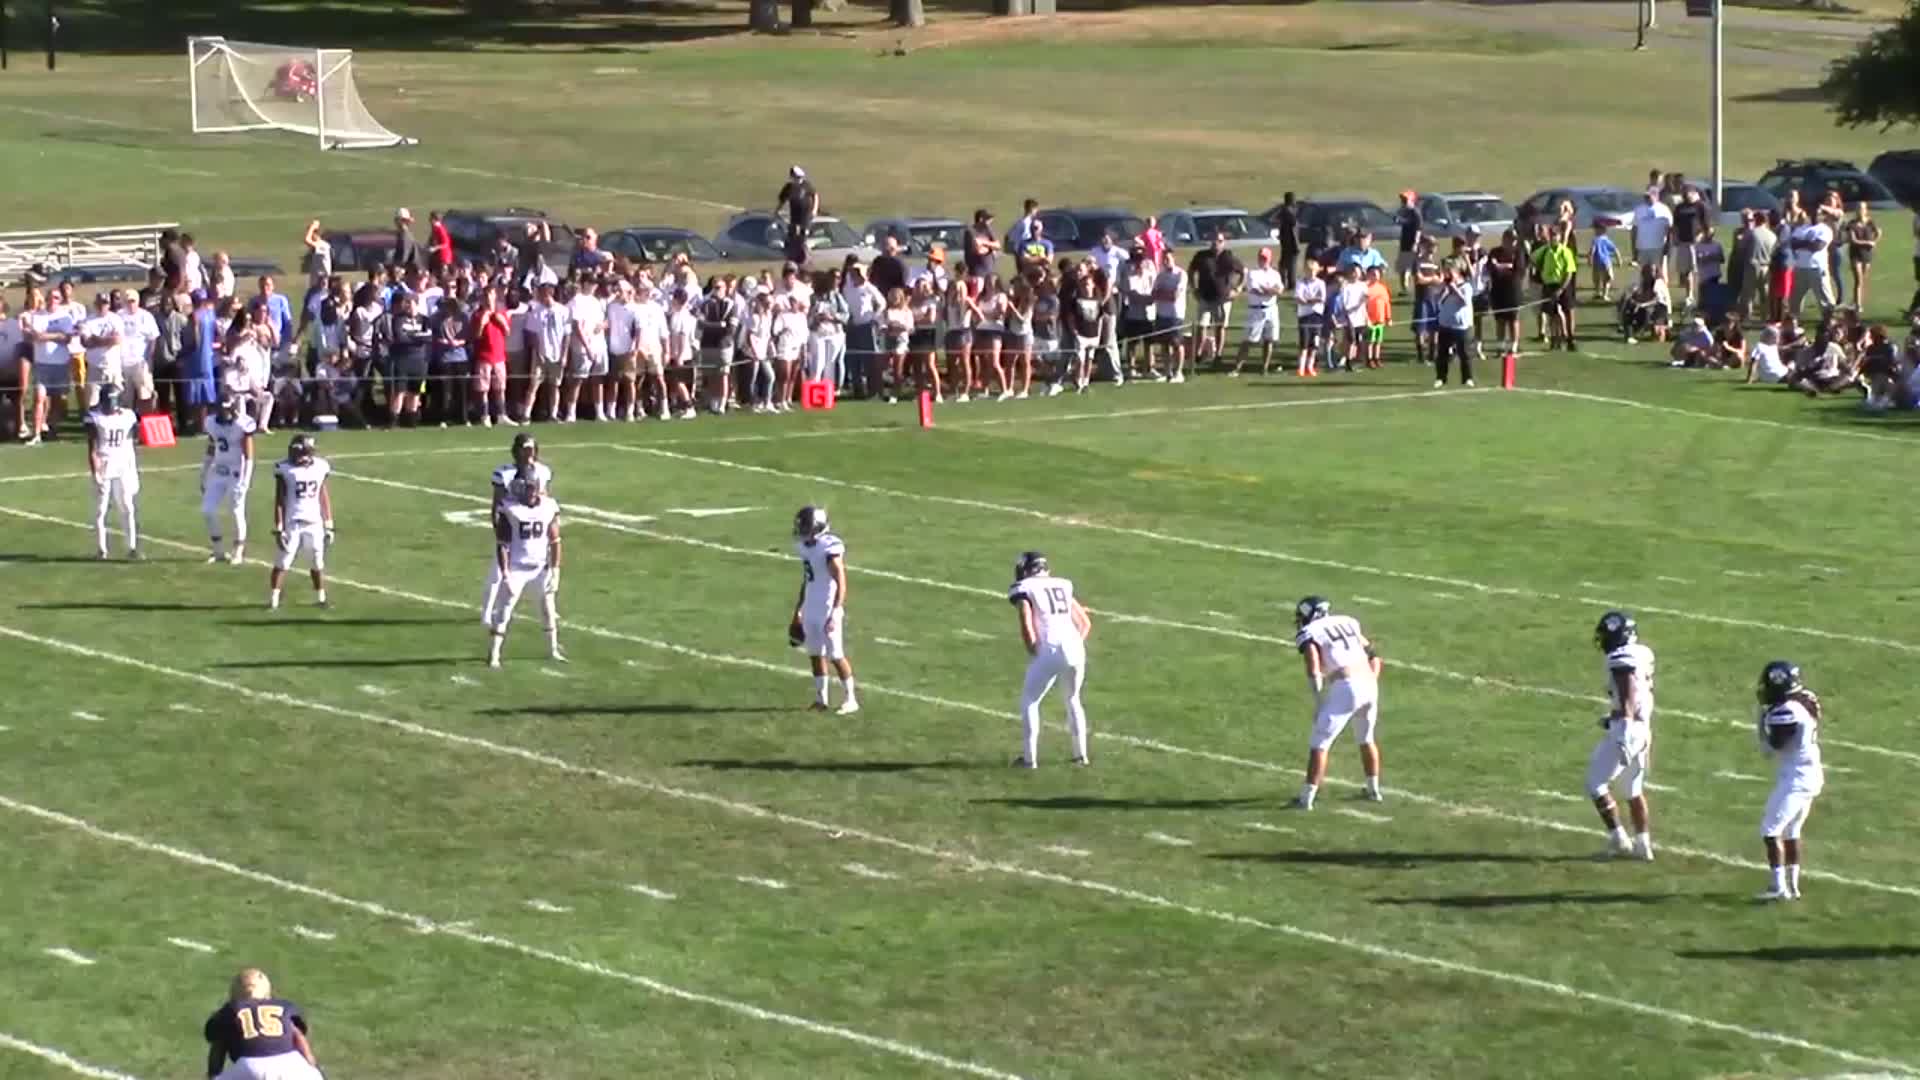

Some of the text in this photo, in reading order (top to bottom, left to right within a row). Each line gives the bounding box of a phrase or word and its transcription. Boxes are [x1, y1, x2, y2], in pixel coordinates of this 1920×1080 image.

[810, 384, 826, 407] G
[147, 419, 170, 443] 10
[295, 480, 318, 498] 23
[1043, 587, 1068, 614] 19
[1323, 623, 1360, 650] 44
[237, 1005, 285, 1039] 15
